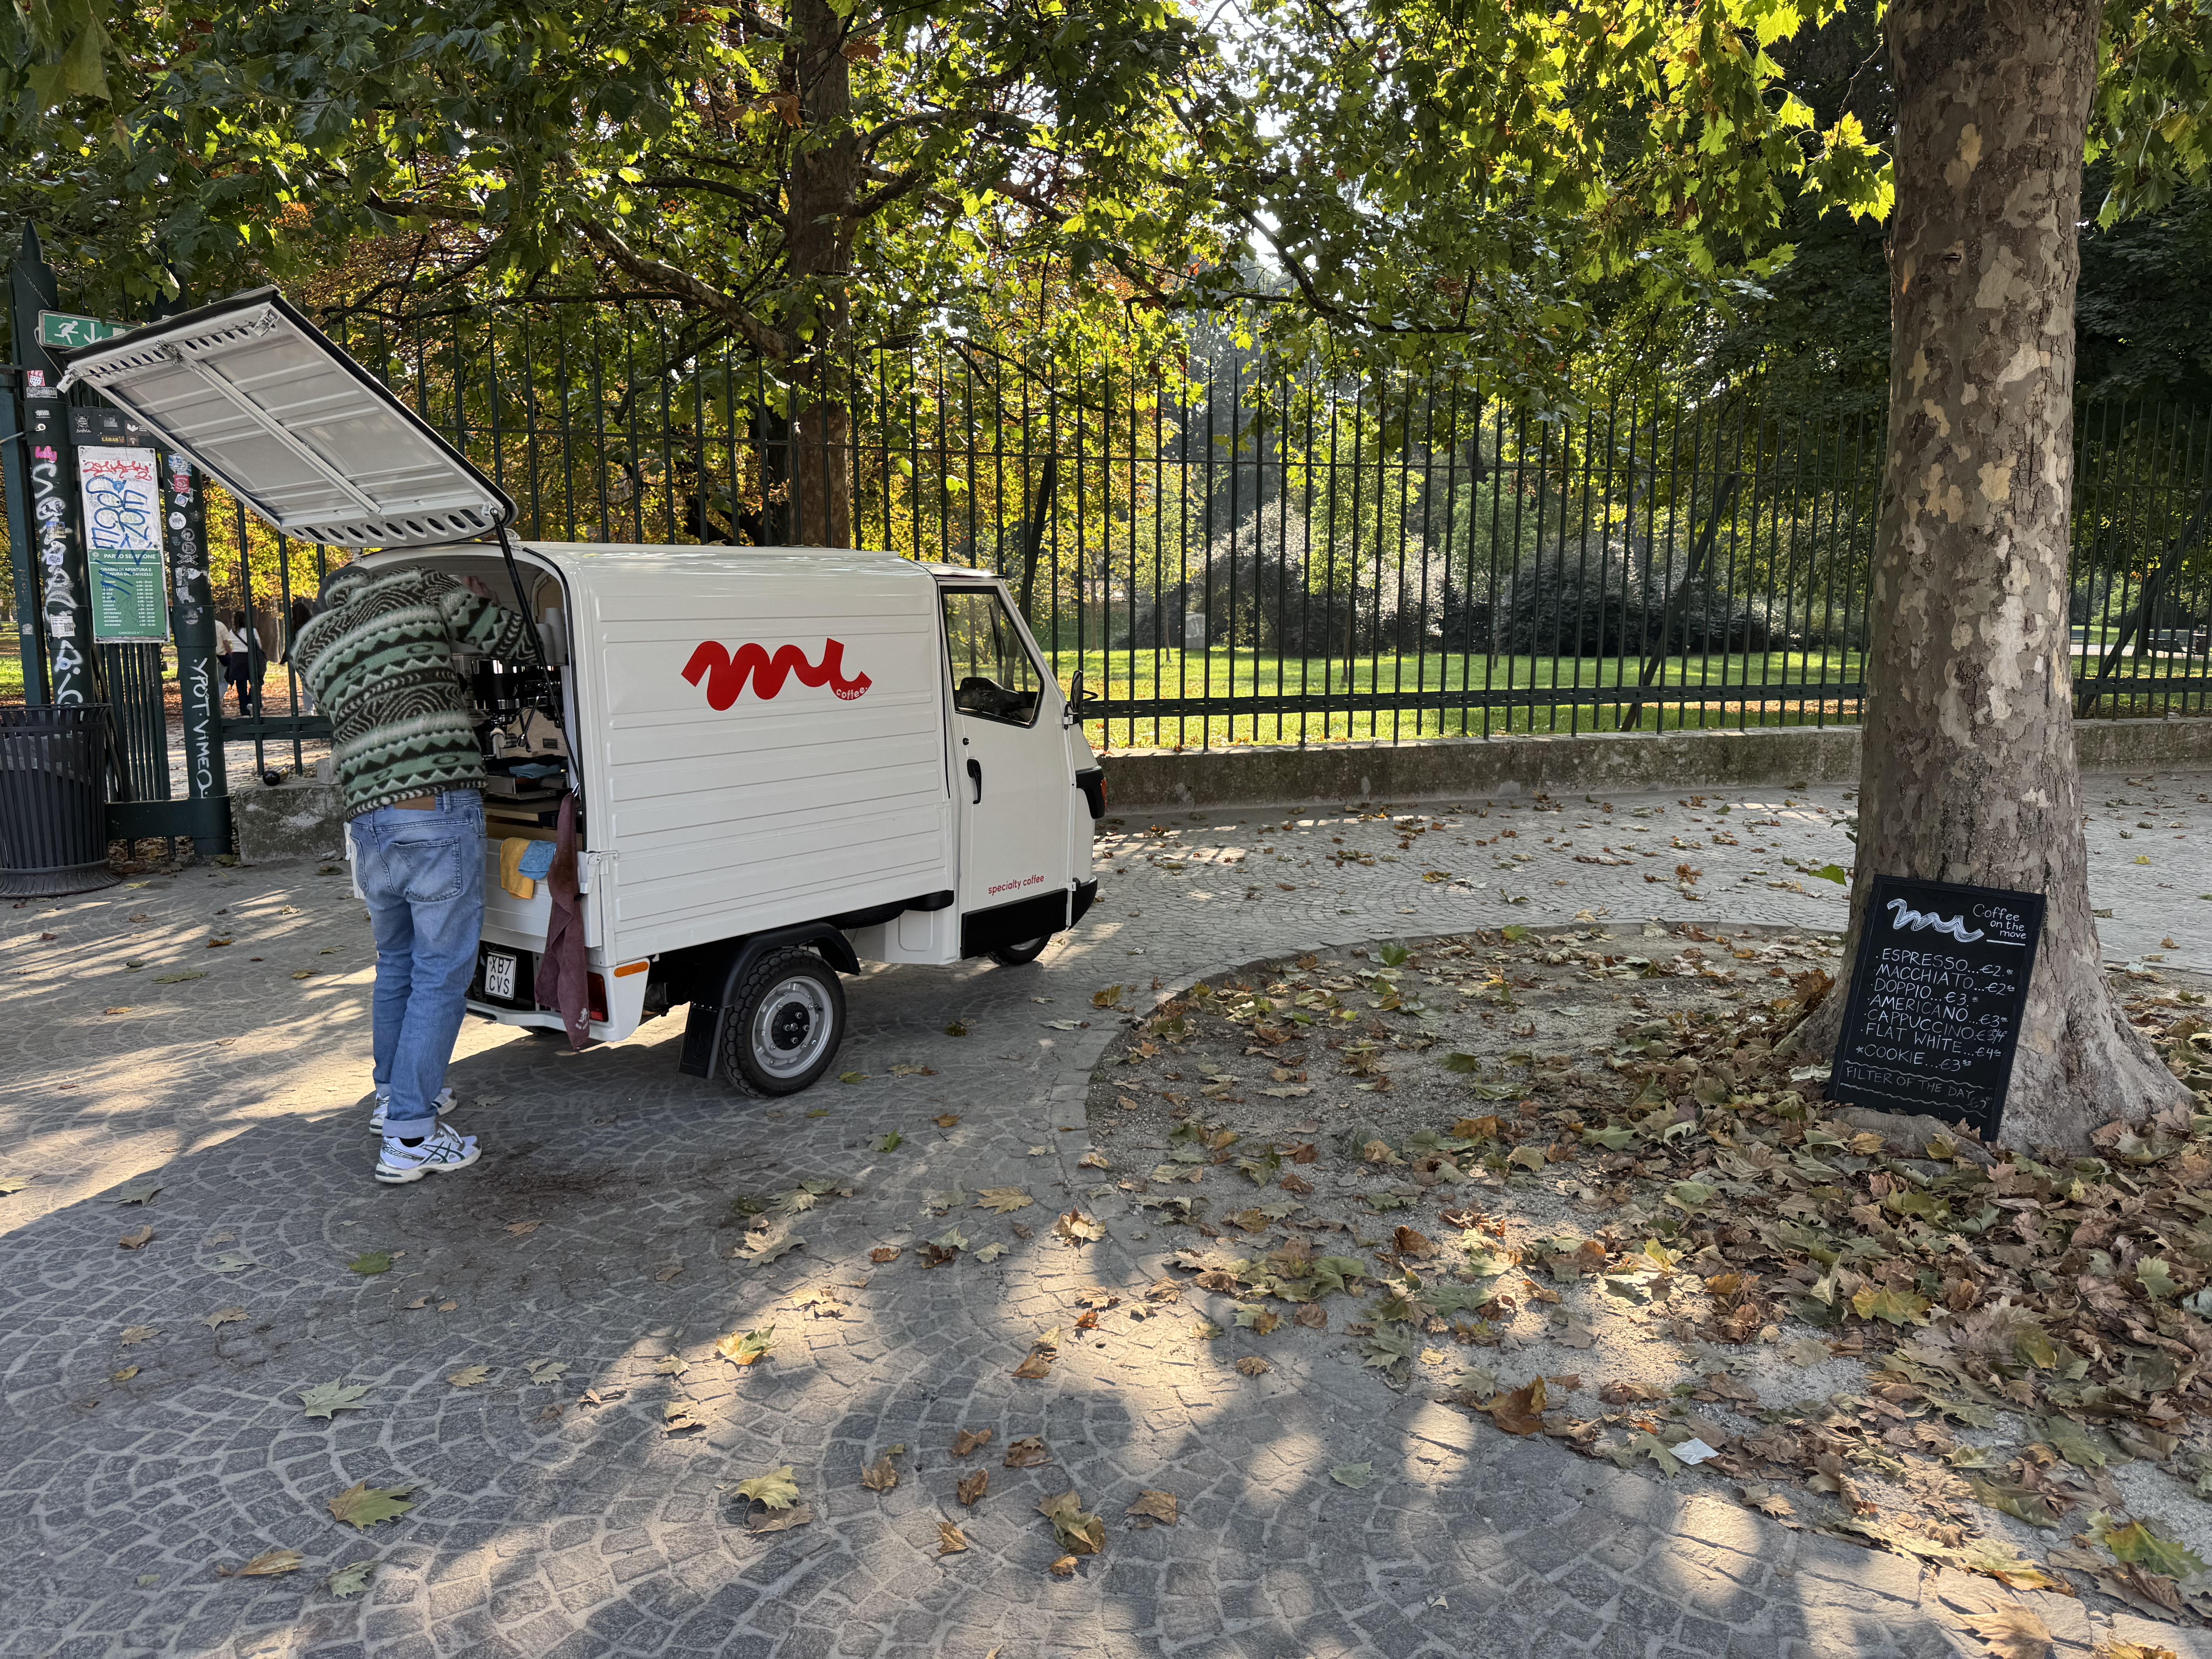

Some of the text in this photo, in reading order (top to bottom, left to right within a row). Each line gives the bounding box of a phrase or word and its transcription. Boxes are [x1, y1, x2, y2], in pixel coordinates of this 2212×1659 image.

[988, 874, 1045, 896] specialty coffee
[1973, 903, 2020, 922] Coffee
[1990, 920, 2025, 931] on the
[1999, 930, 2027, 939] move
[490, 956, 514, 975] XB7
[489, 974, 510, 995] CVS
[1866, 1022, 1908, 1042] FLAT
[1846, 1066, 1975, 1100] FILTER OF THE DAY
